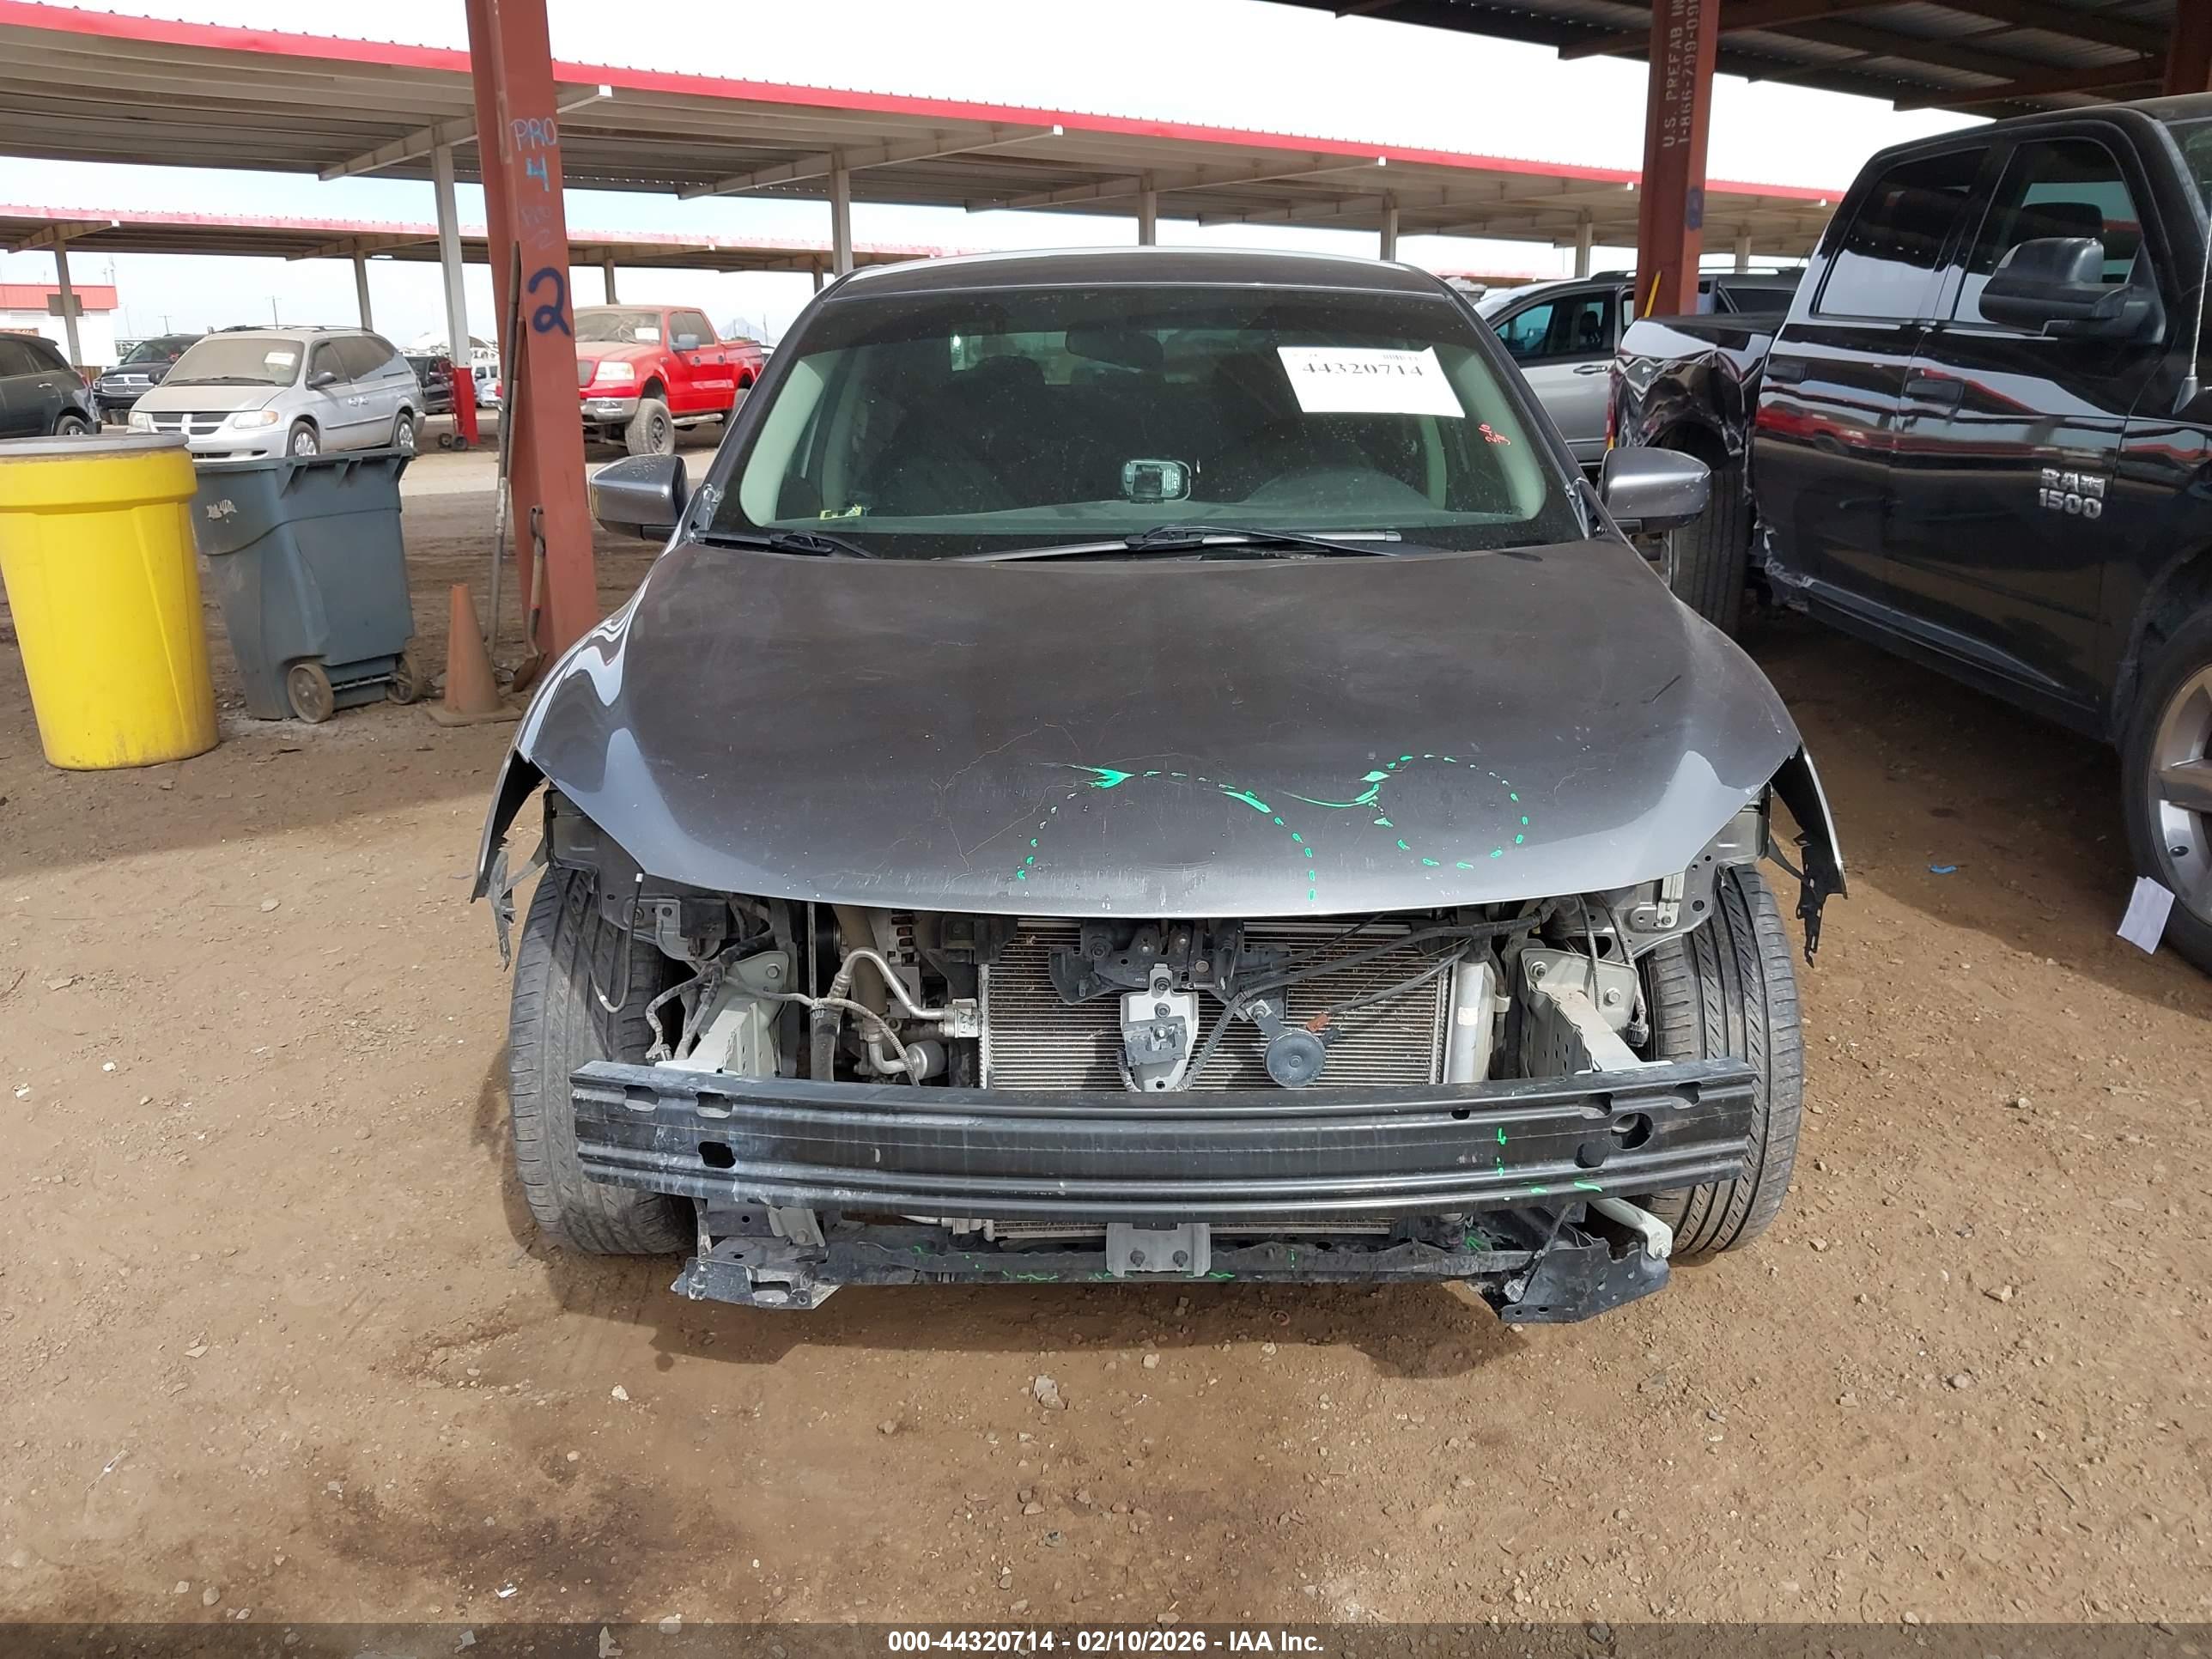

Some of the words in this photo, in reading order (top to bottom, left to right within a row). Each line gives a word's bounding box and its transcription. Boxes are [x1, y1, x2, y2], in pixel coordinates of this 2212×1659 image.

[1666, 27, 1682, 101] PREFAB
[510, 117, 557, 151] PRO
[526, 154, 550, 192] 4
[527, 267, 571, 336] 2
[1303, 358, 1424, 376] 44320714
[2041, 467, 2106, 498] RAM
[2039, 488, 2102, 519] 1500
